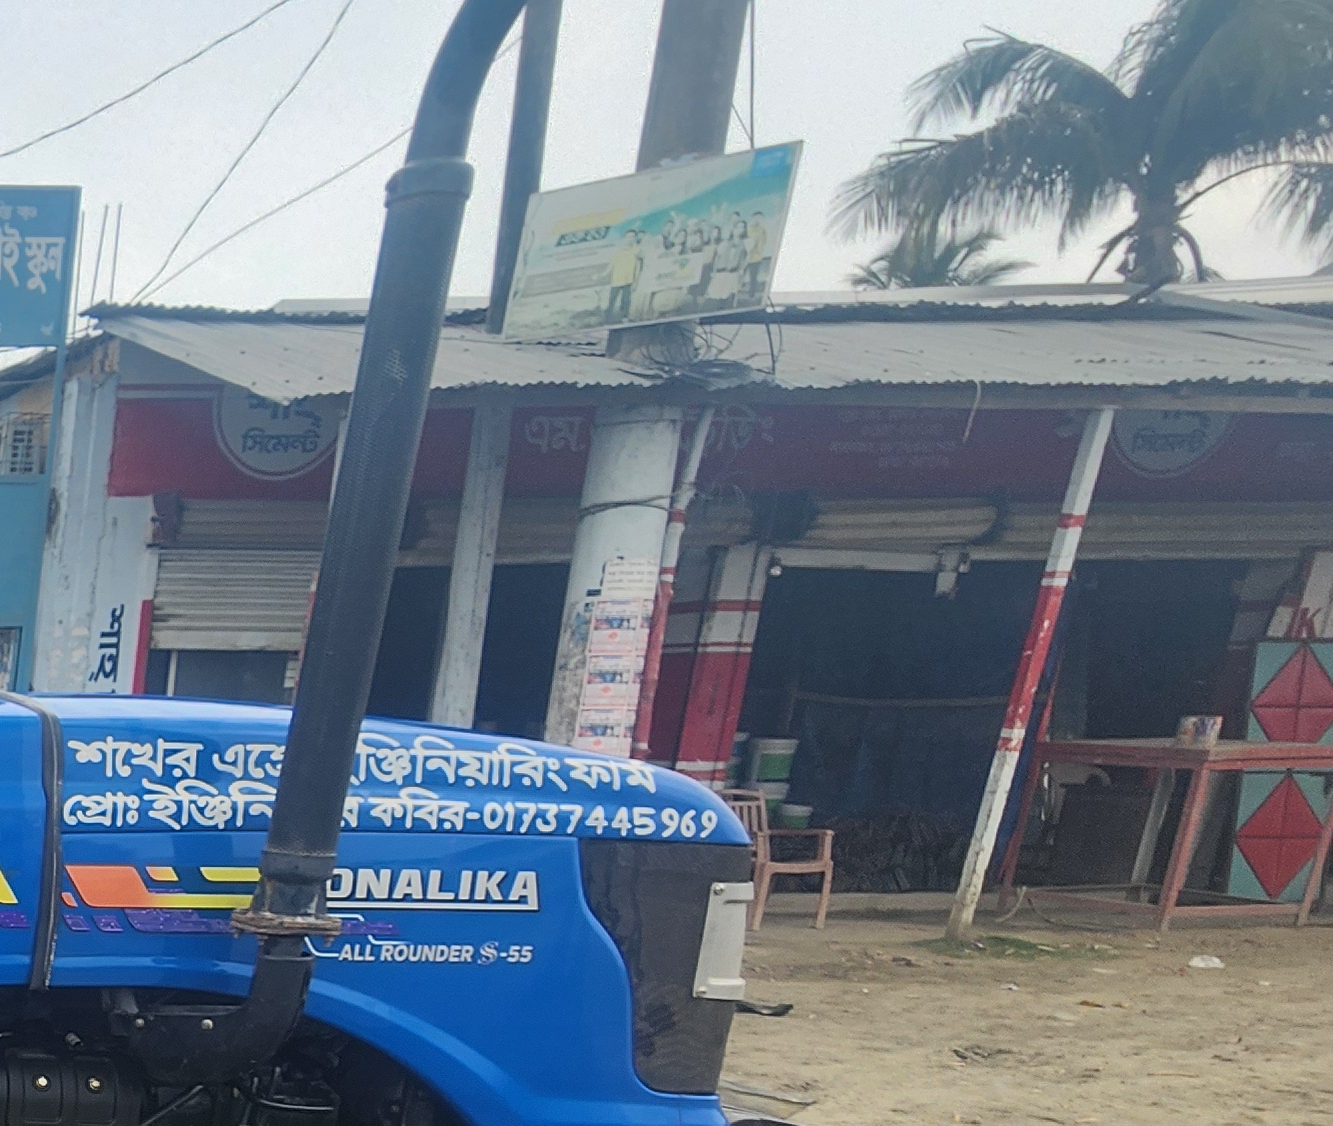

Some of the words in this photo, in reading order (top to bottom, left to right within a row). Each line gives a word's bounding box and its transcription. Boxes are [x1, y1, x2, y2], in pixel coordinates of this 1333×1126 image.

[25, 236, 65, 294] স্কুল
[242, 426, 321, 454] সিমেন্ট
[67, 736, 204, 778] শখের
[62, 791, 140, 828] প্রোঃ
[326, 868, 538, 906] ONALIKA
[338, 943, 376, 961] ALL
[380, 944, 474, 963] ROUNDER
